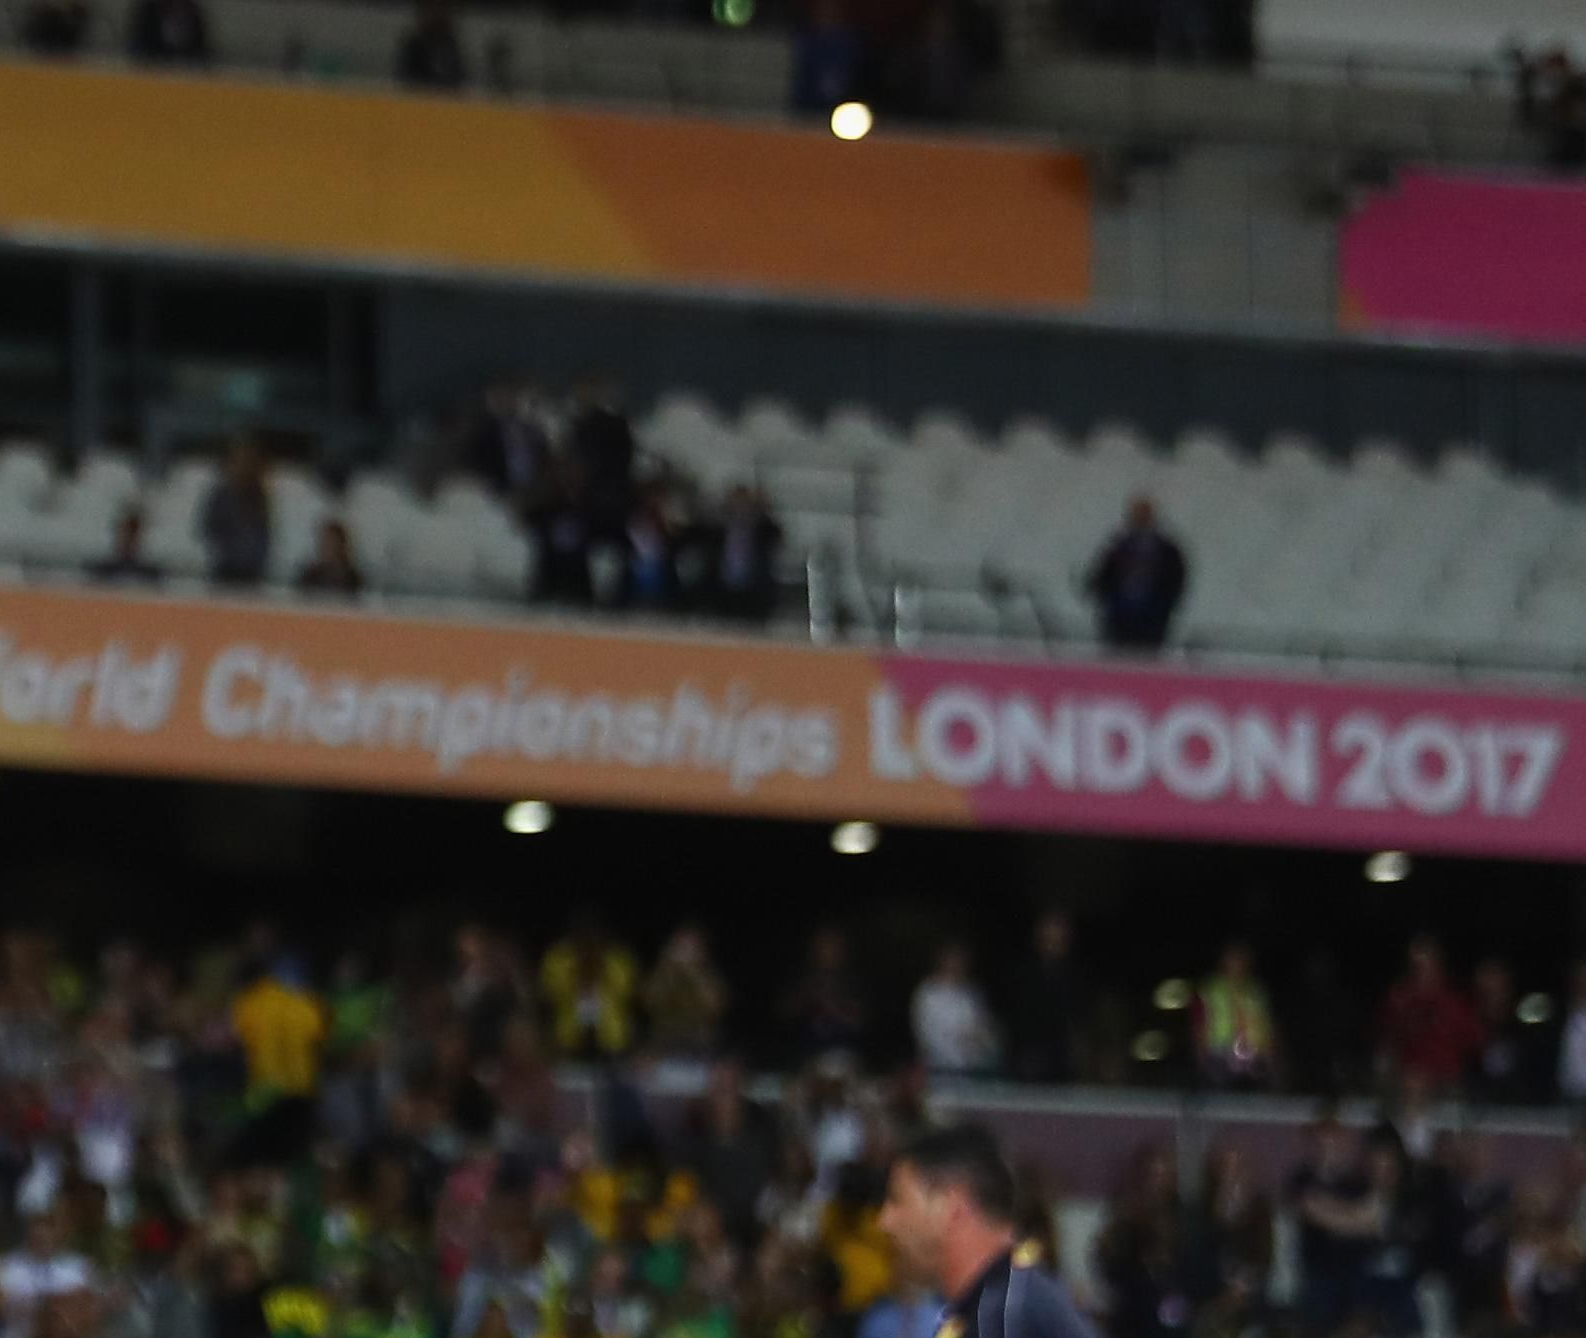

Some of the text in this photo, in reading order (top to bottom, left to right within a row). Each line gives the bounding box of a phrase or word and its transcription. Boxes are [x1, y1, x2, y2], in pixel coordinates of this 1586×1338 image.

[200, 642, 841, 794] Championships
[868, 681, 1320, 807] LONDON
[1330, 709, 1567, 819] 2017
